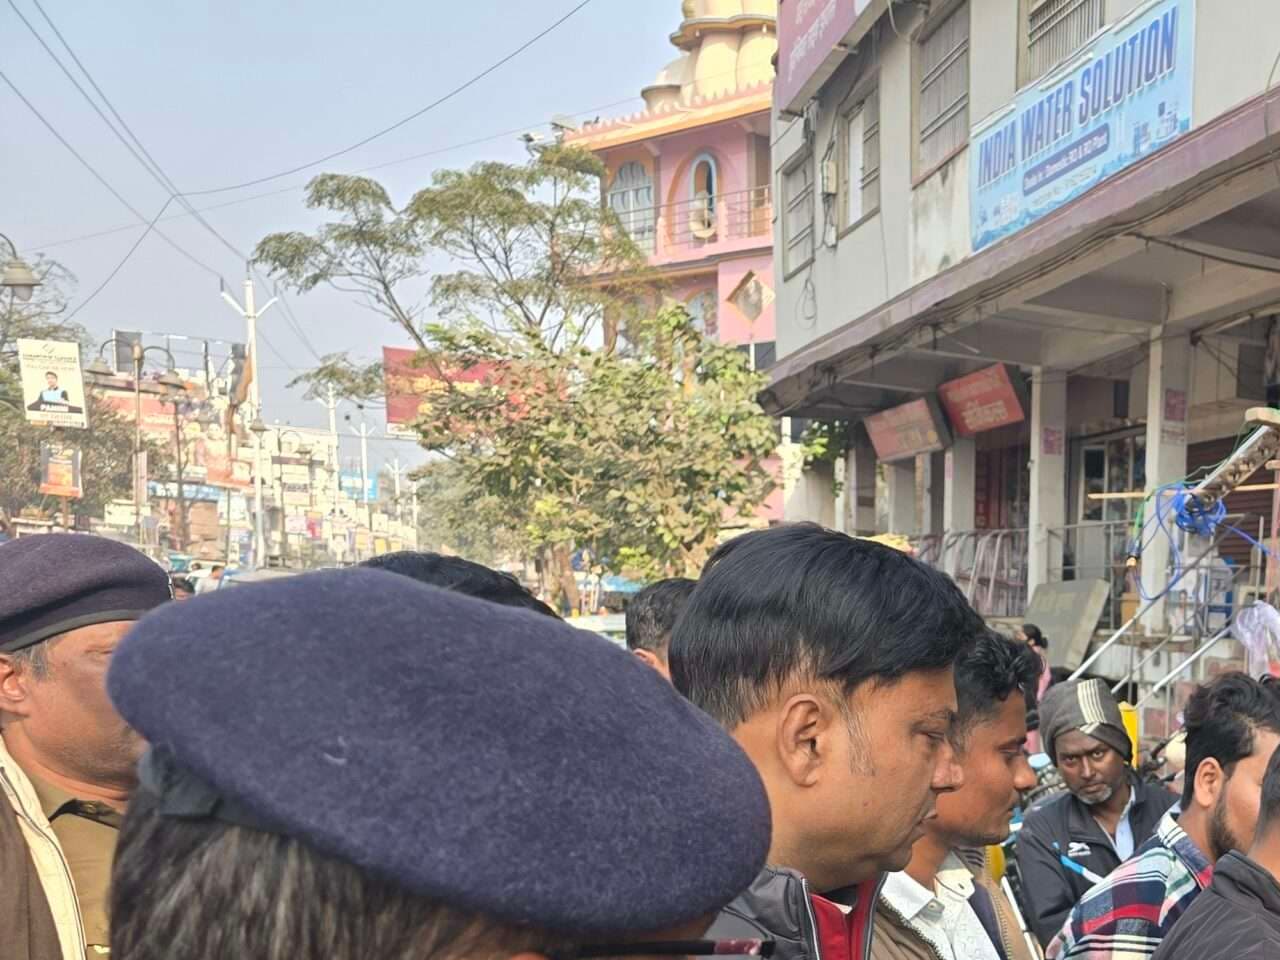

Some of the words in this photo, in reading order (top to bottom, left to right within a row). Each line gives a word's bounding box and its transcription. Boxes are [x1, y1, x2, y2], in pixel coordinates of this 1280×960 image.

[978, 119, 1017, 189] INDIA
[1021, 79, 1074, 162] WATER
[1079, 5, 1179, 126] SOLUTION
